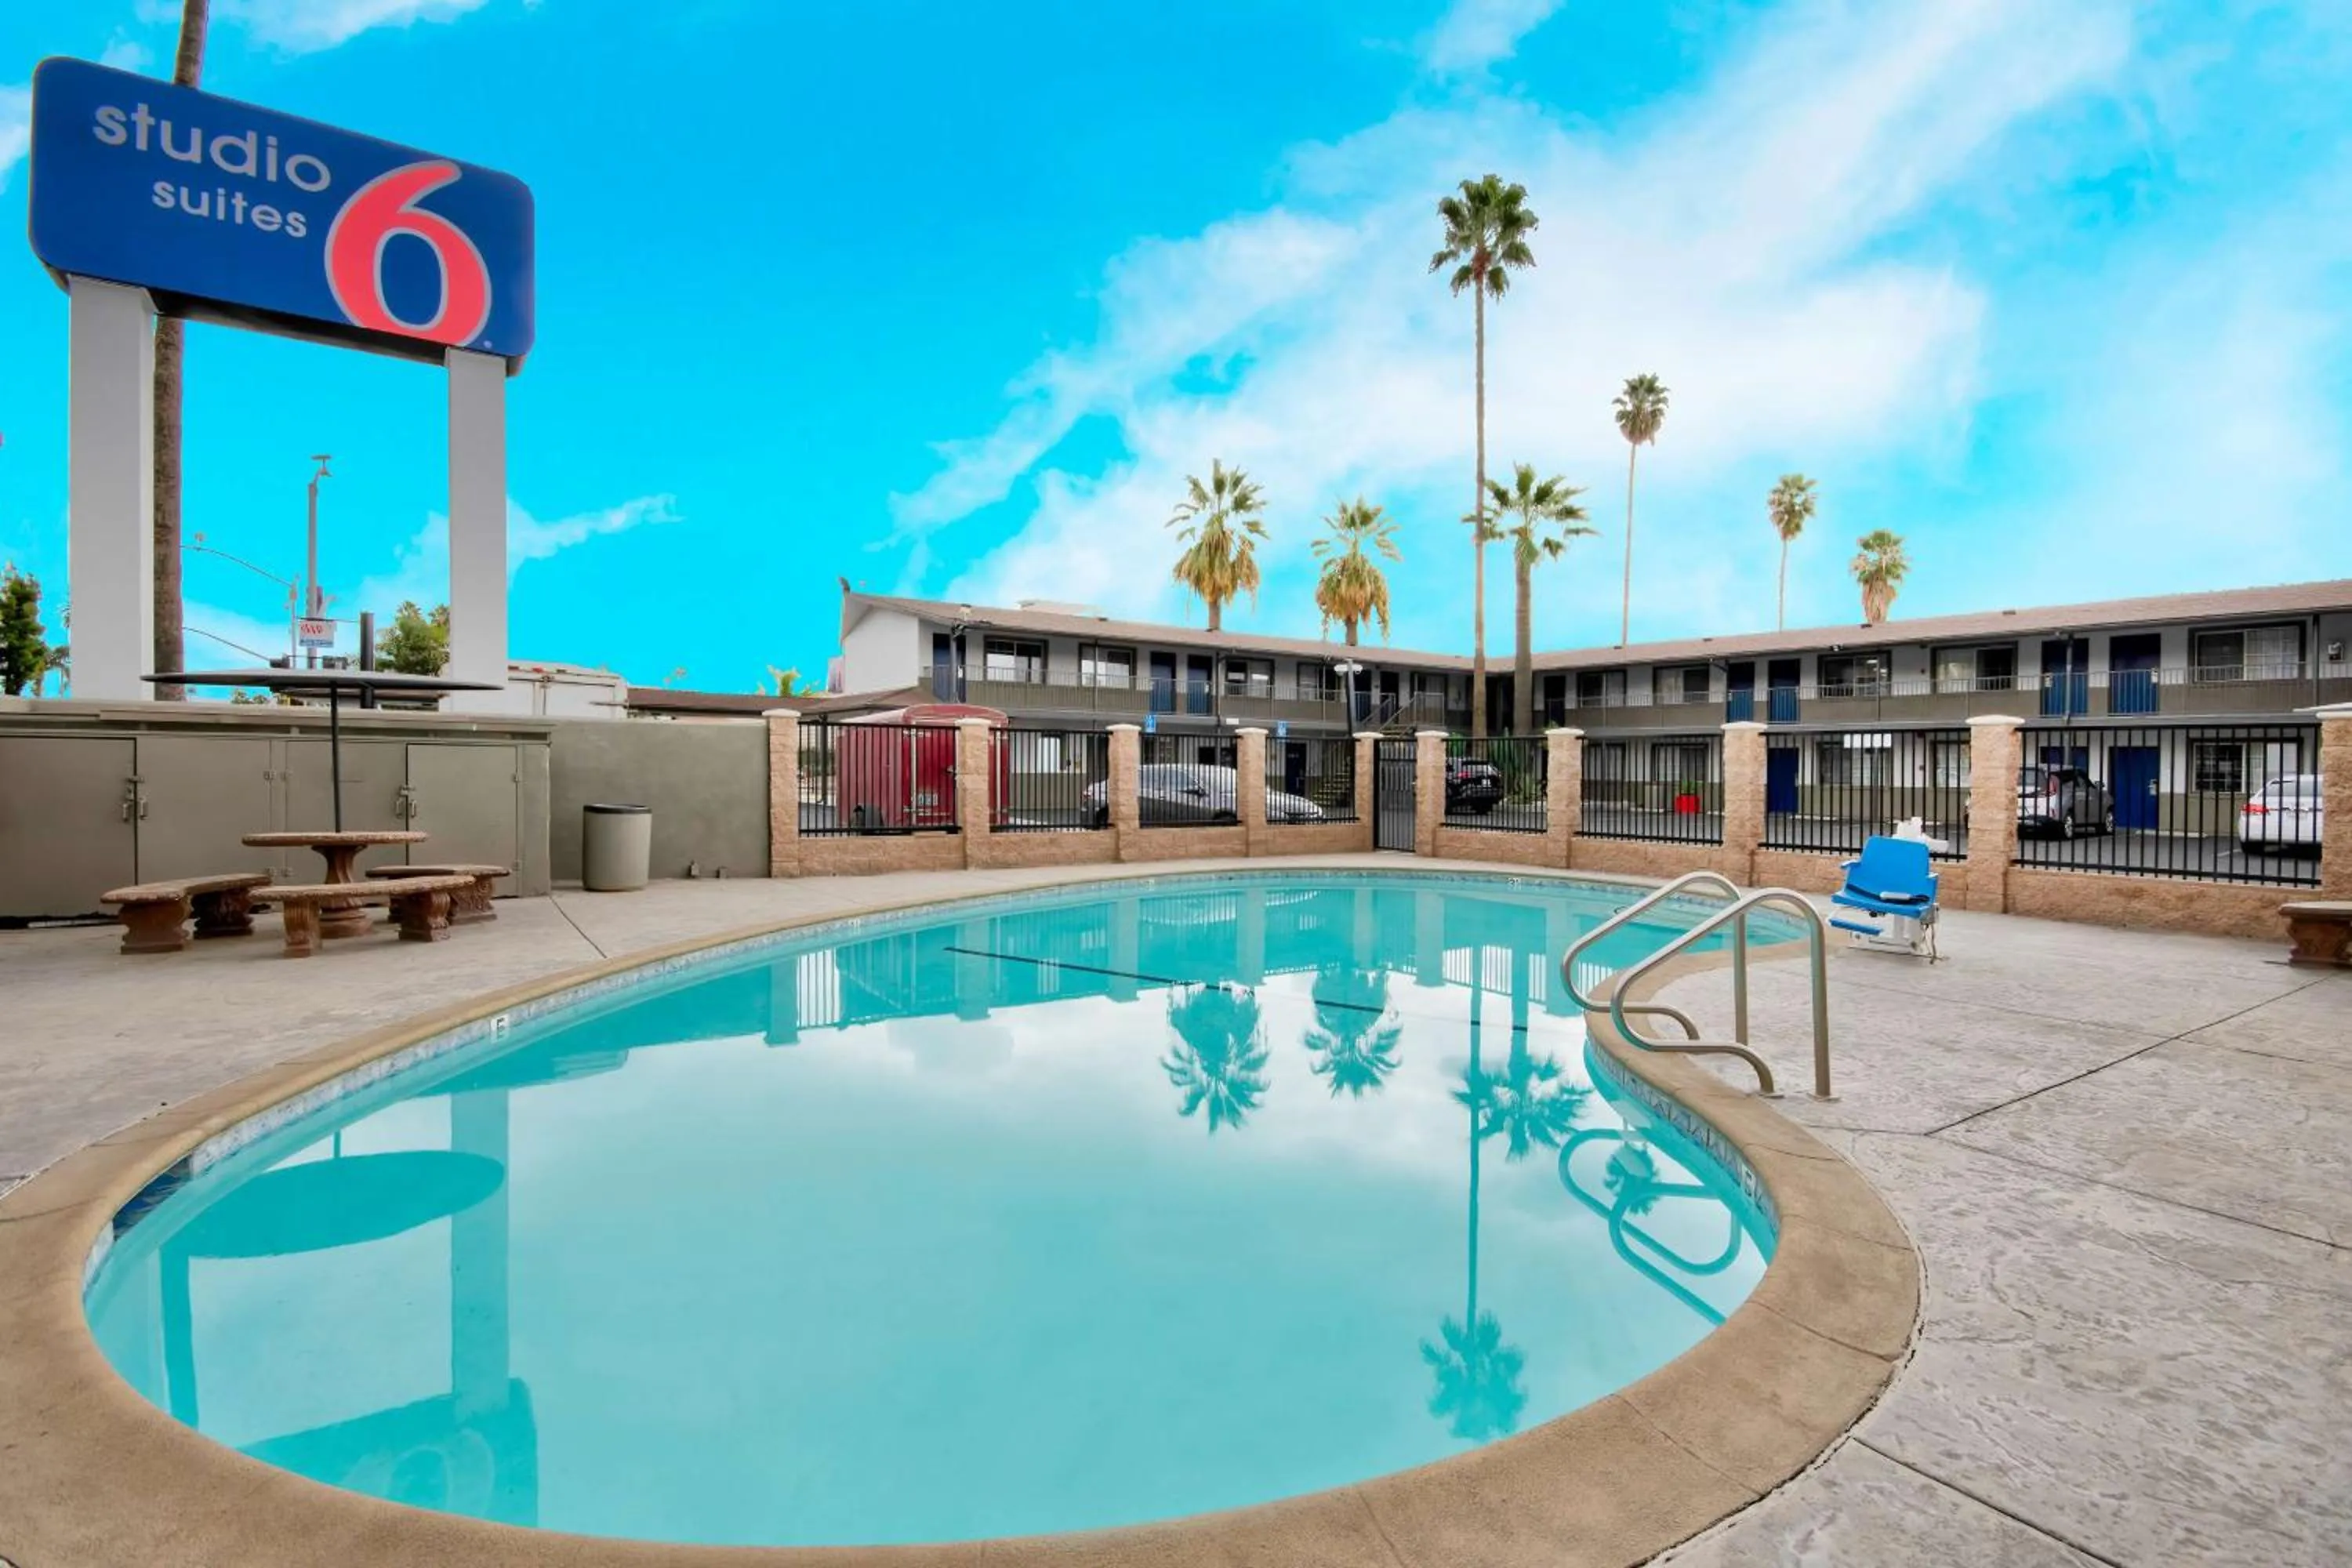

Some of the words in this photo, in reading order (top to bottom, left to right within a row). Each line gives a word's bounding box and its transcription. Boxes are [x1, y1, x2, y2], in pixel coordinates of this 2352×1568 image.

[93, 103, 331, 191] studio
[152, 181, 307, 238] suites
[325, 160, 492, 347] 6
